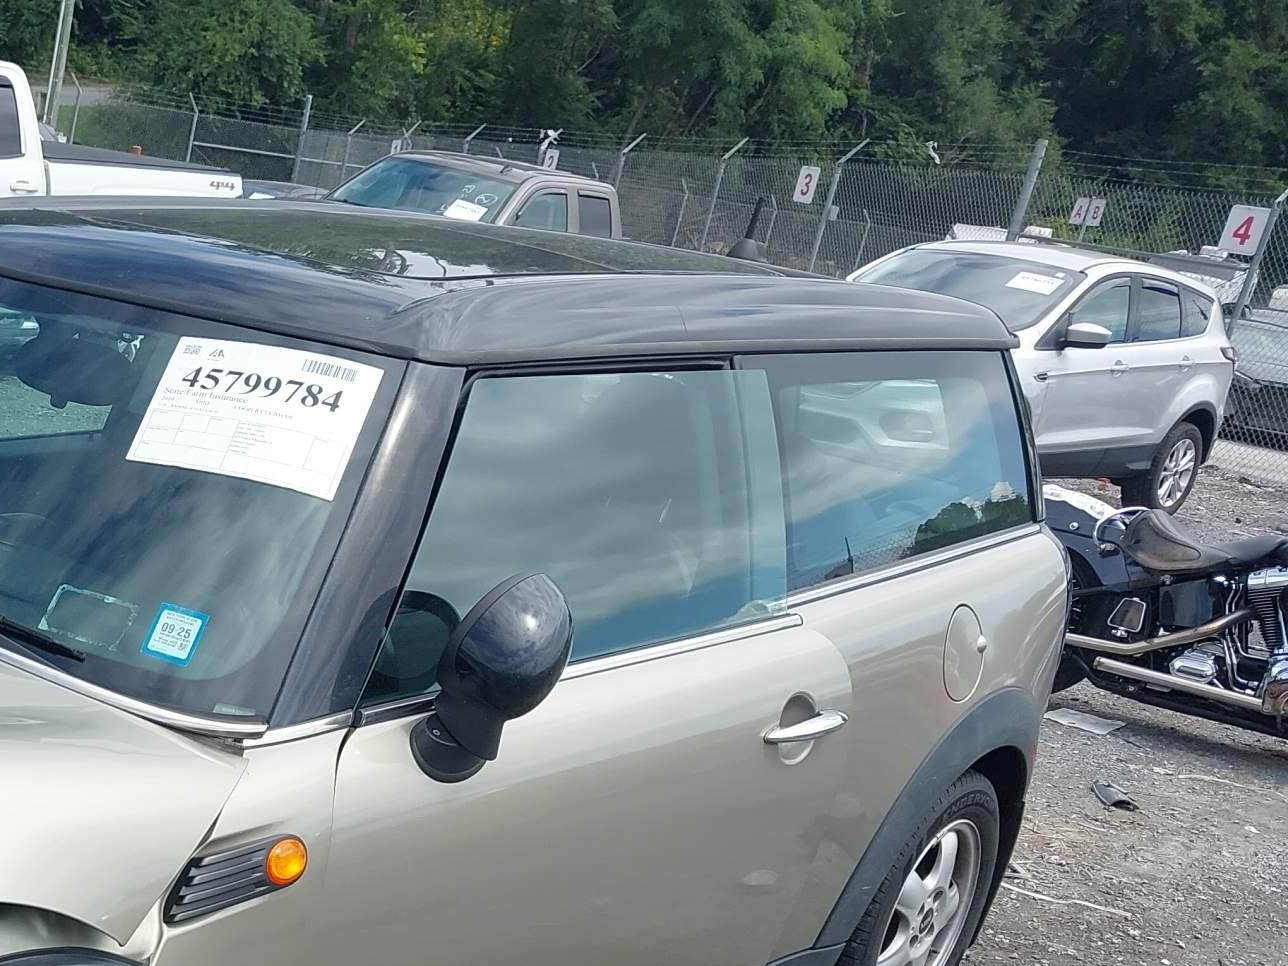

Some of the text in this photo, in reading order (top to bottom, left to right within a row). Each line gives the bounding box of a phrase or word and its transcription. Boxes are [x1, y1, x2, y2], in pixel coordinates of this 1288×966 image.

[800, 173, 813, 196] 3
[1073, 205, 1082, 218] A
[1092, 206, 1100, 219] B
[1232, 216, 1255, 245] 4
[182, 366, 343, 413] 45799784
